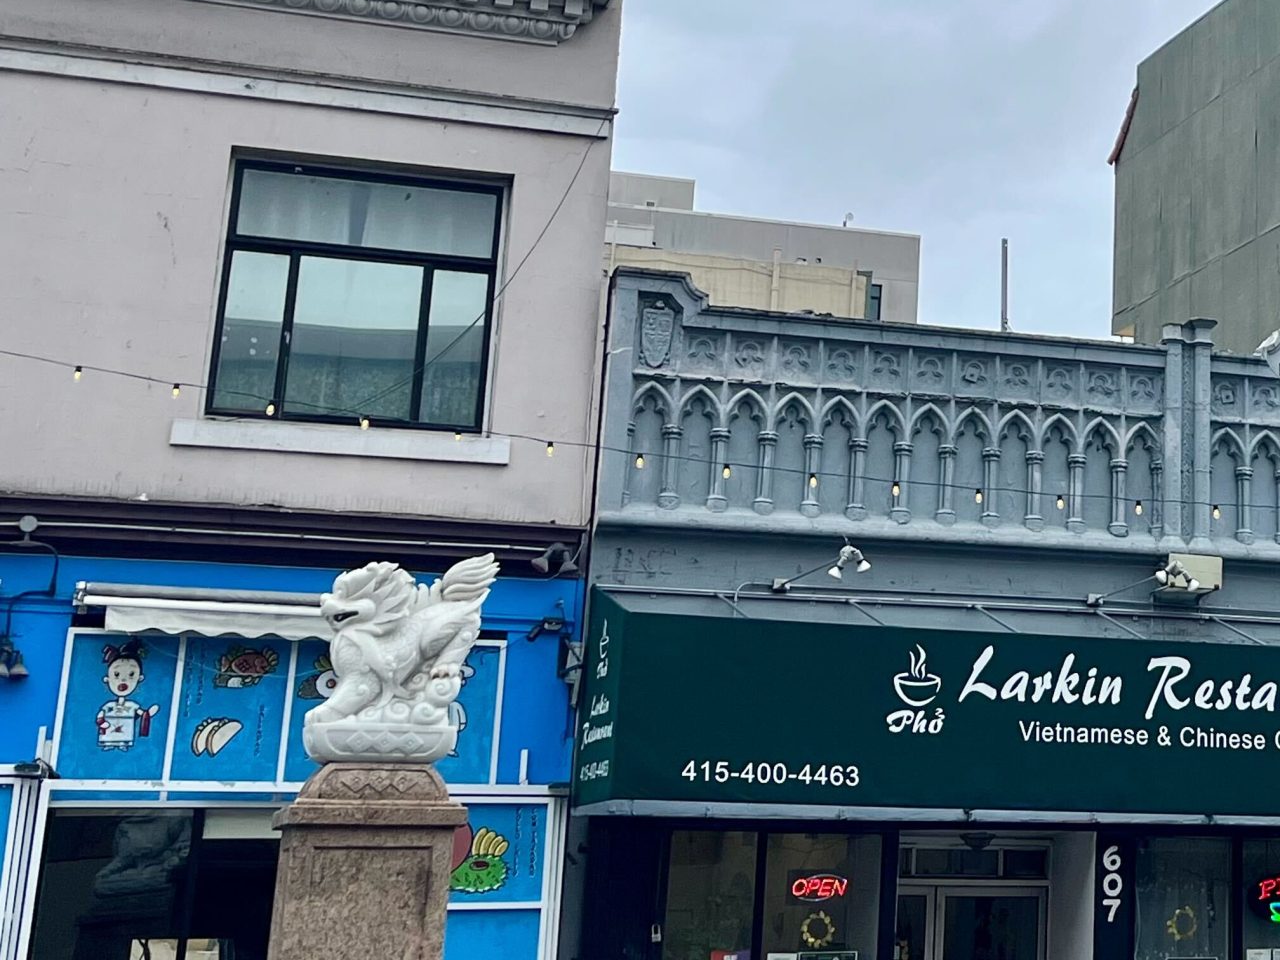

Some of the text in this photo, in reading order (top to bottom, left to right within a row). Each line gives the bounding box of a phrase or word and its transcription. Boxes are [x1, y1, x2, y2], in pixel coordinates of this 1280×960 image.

[957, 645, 1122, 703] Larkin
[1019, 720, 1149, 745] Vietnamese
[1157, 726, 1171, 746] &
[1180, 727, 1265, 749] Chinese
[681, 760, 860, 787] 415-400-4463
[792, 878, 848, 897] OPEN
